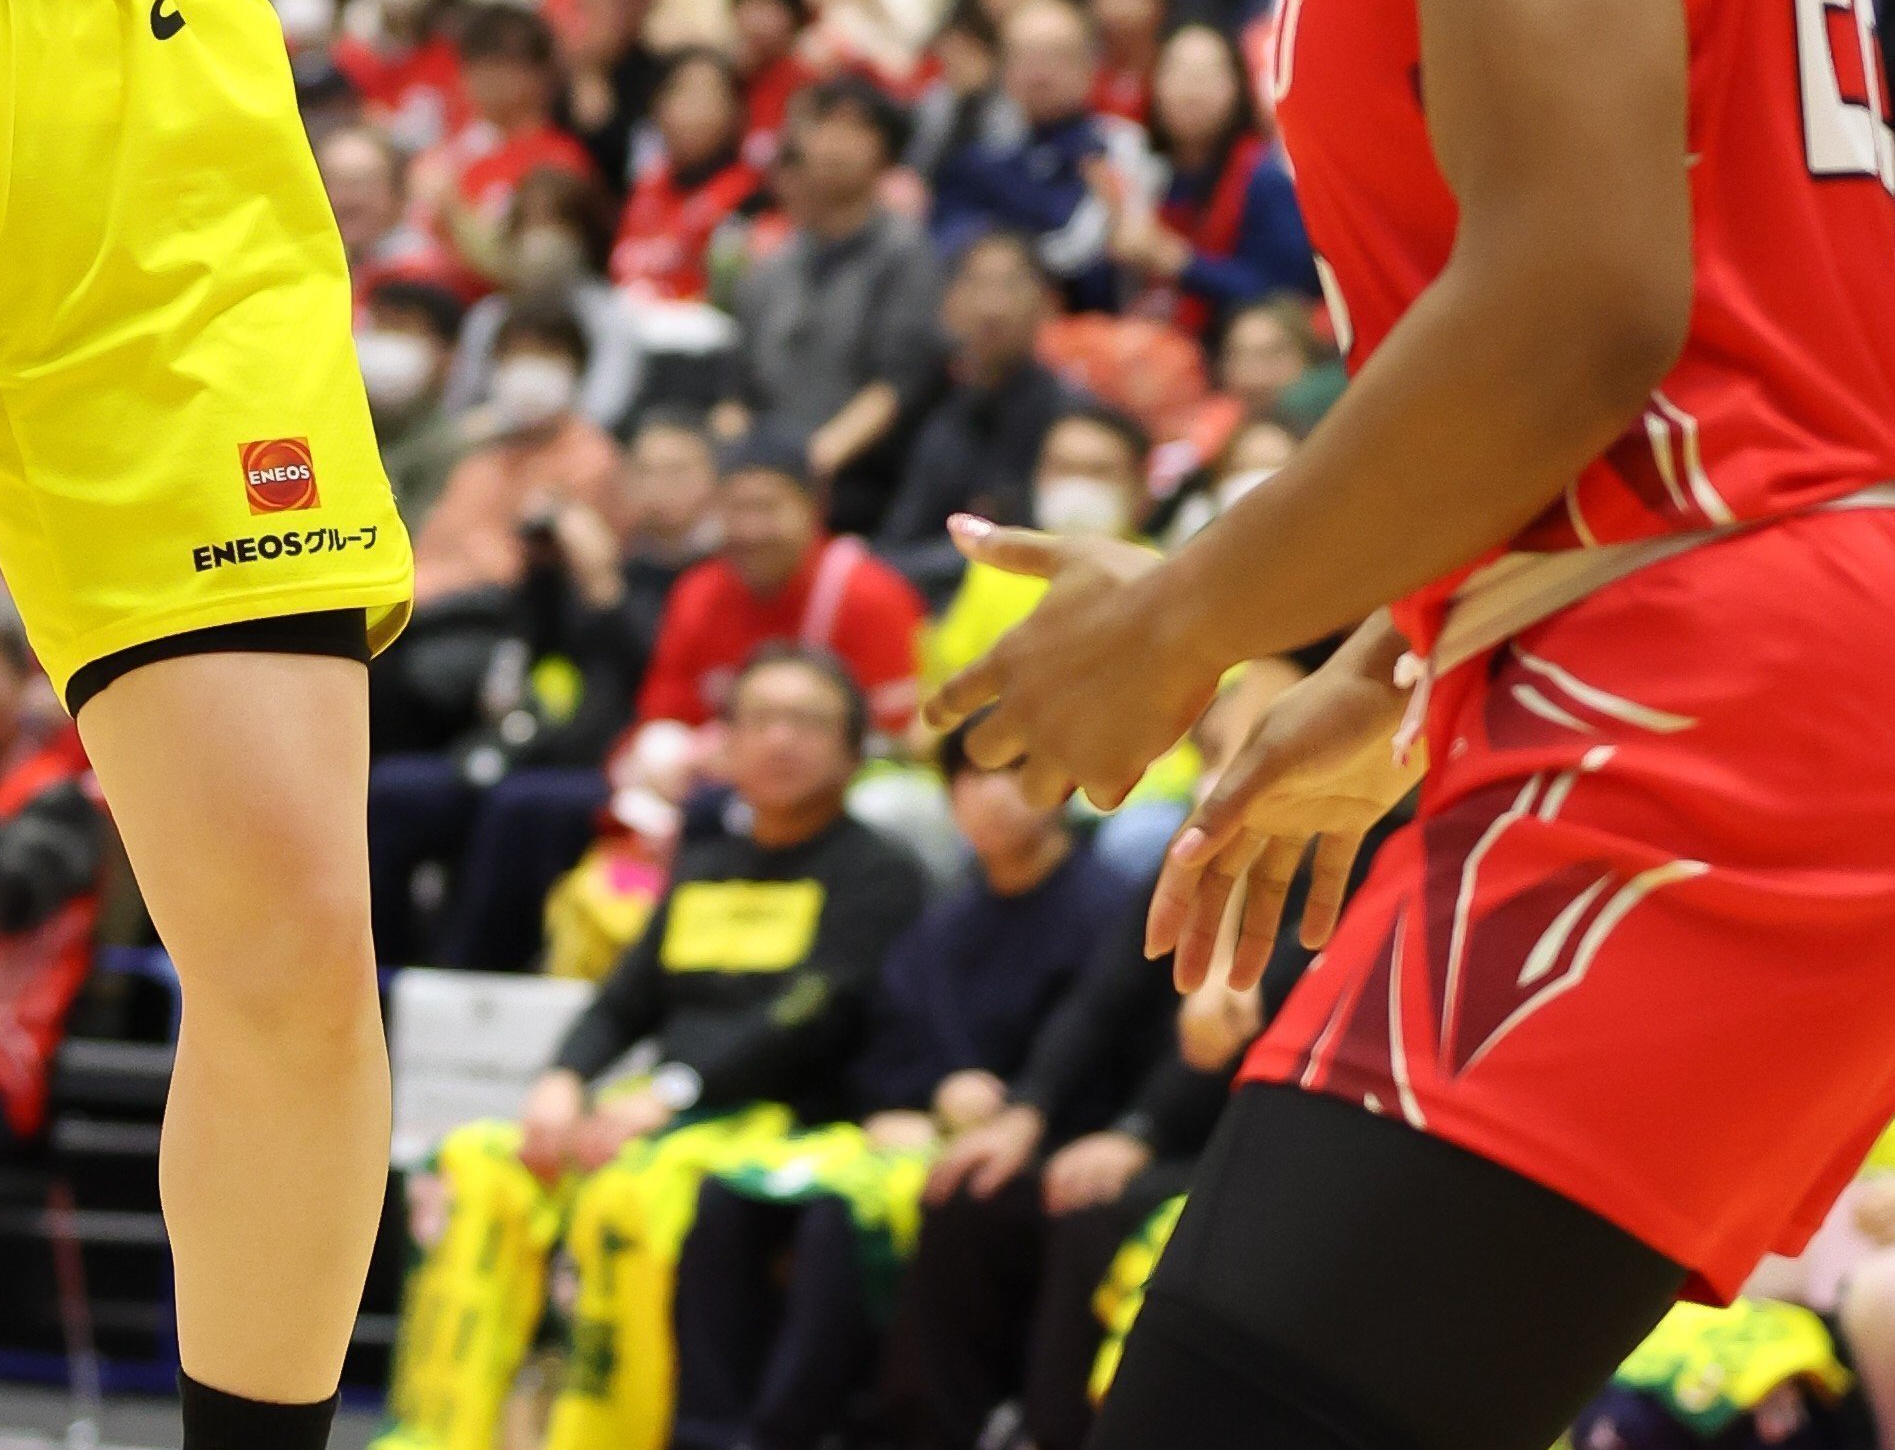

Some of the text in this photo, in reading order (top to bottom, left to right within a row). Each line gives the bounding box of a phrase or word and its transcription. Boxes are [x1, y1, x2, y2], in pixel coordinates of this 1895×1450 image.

[248, 465, 310, 486] ENEOS
[192, 525, 378, 572] ENEOSグループ
